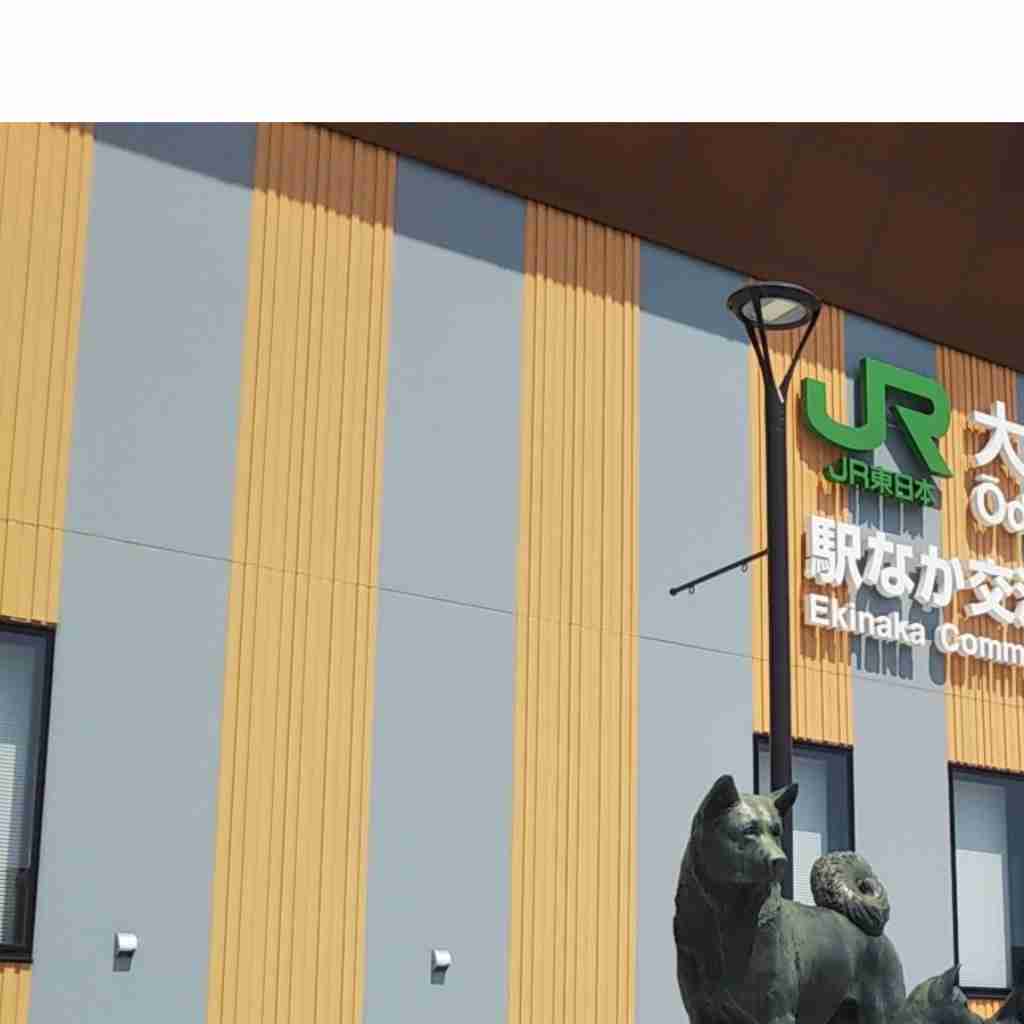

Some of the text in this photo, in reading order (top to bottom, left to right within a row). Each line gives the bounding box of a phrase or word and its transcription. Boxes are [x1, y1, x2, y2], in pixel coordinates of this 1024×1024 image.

[801, 357, 953, 477] JR
[824, 457, 937, 507] JR東日本
[806, 592, 926, 647] Ekinaka
